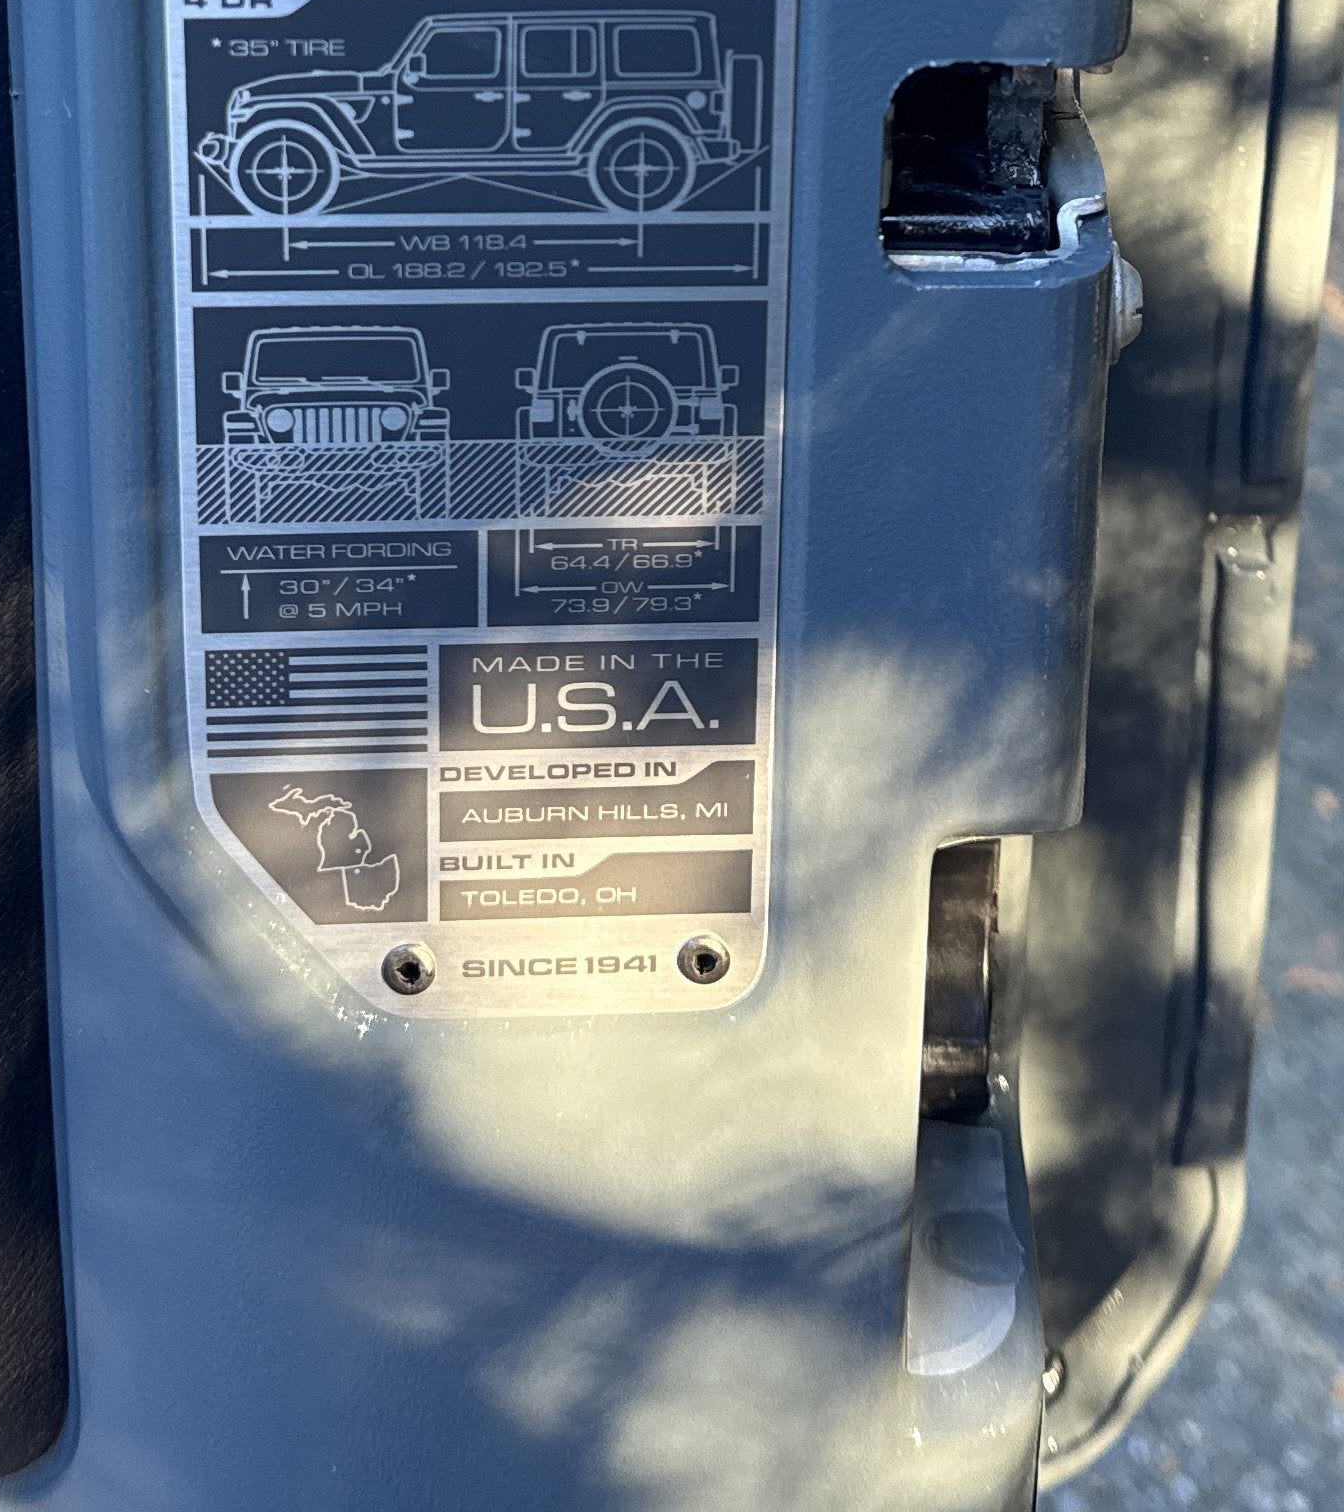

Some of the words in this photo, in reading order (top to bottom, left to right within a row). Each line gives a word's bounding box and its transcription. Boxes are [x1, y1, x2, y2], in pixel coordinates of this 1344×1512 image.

[286, 39, 346, 57] TIRE
[400, 235, 451, 251] WB
[458, 234, 527, 251] 118.4
[347, 263, 385, 279] OL
[392, 262, 465, 279] 188.2
[226, 544, 325, 561] WATER
[331, 541, 452, 558] FORDING
[608, 537, 638, 551] TR
[601, 580, 645, 594] OW
[278, 604, 297, 619] @
[308, 602, 327, 618] 5
[335, 601, 402, 618] MPH
[471, 654, 585, 673] MADE
[600, 653, 636, 671] IN
[652, 651, 724, 670] THE
[471, 680, 720, 735] U.S.A.
[439, 763, 636, 783] DEVELOPED
[643, 761, 676, 777] IN
[461, 805, 590, 824] AUBURN
[598, 803, 687, 822] HILLS,
[695, 802, 729, 819] MI
[439, 855, 533, 872] BUILT
[542, 853, 575, 869] IN
[461, 888, 587, 907] TOLEDO,
[595, 886, 637, 903] OH
[462, 958, 578, 978] SINCE
[584, 955, 658, 974] 1941
